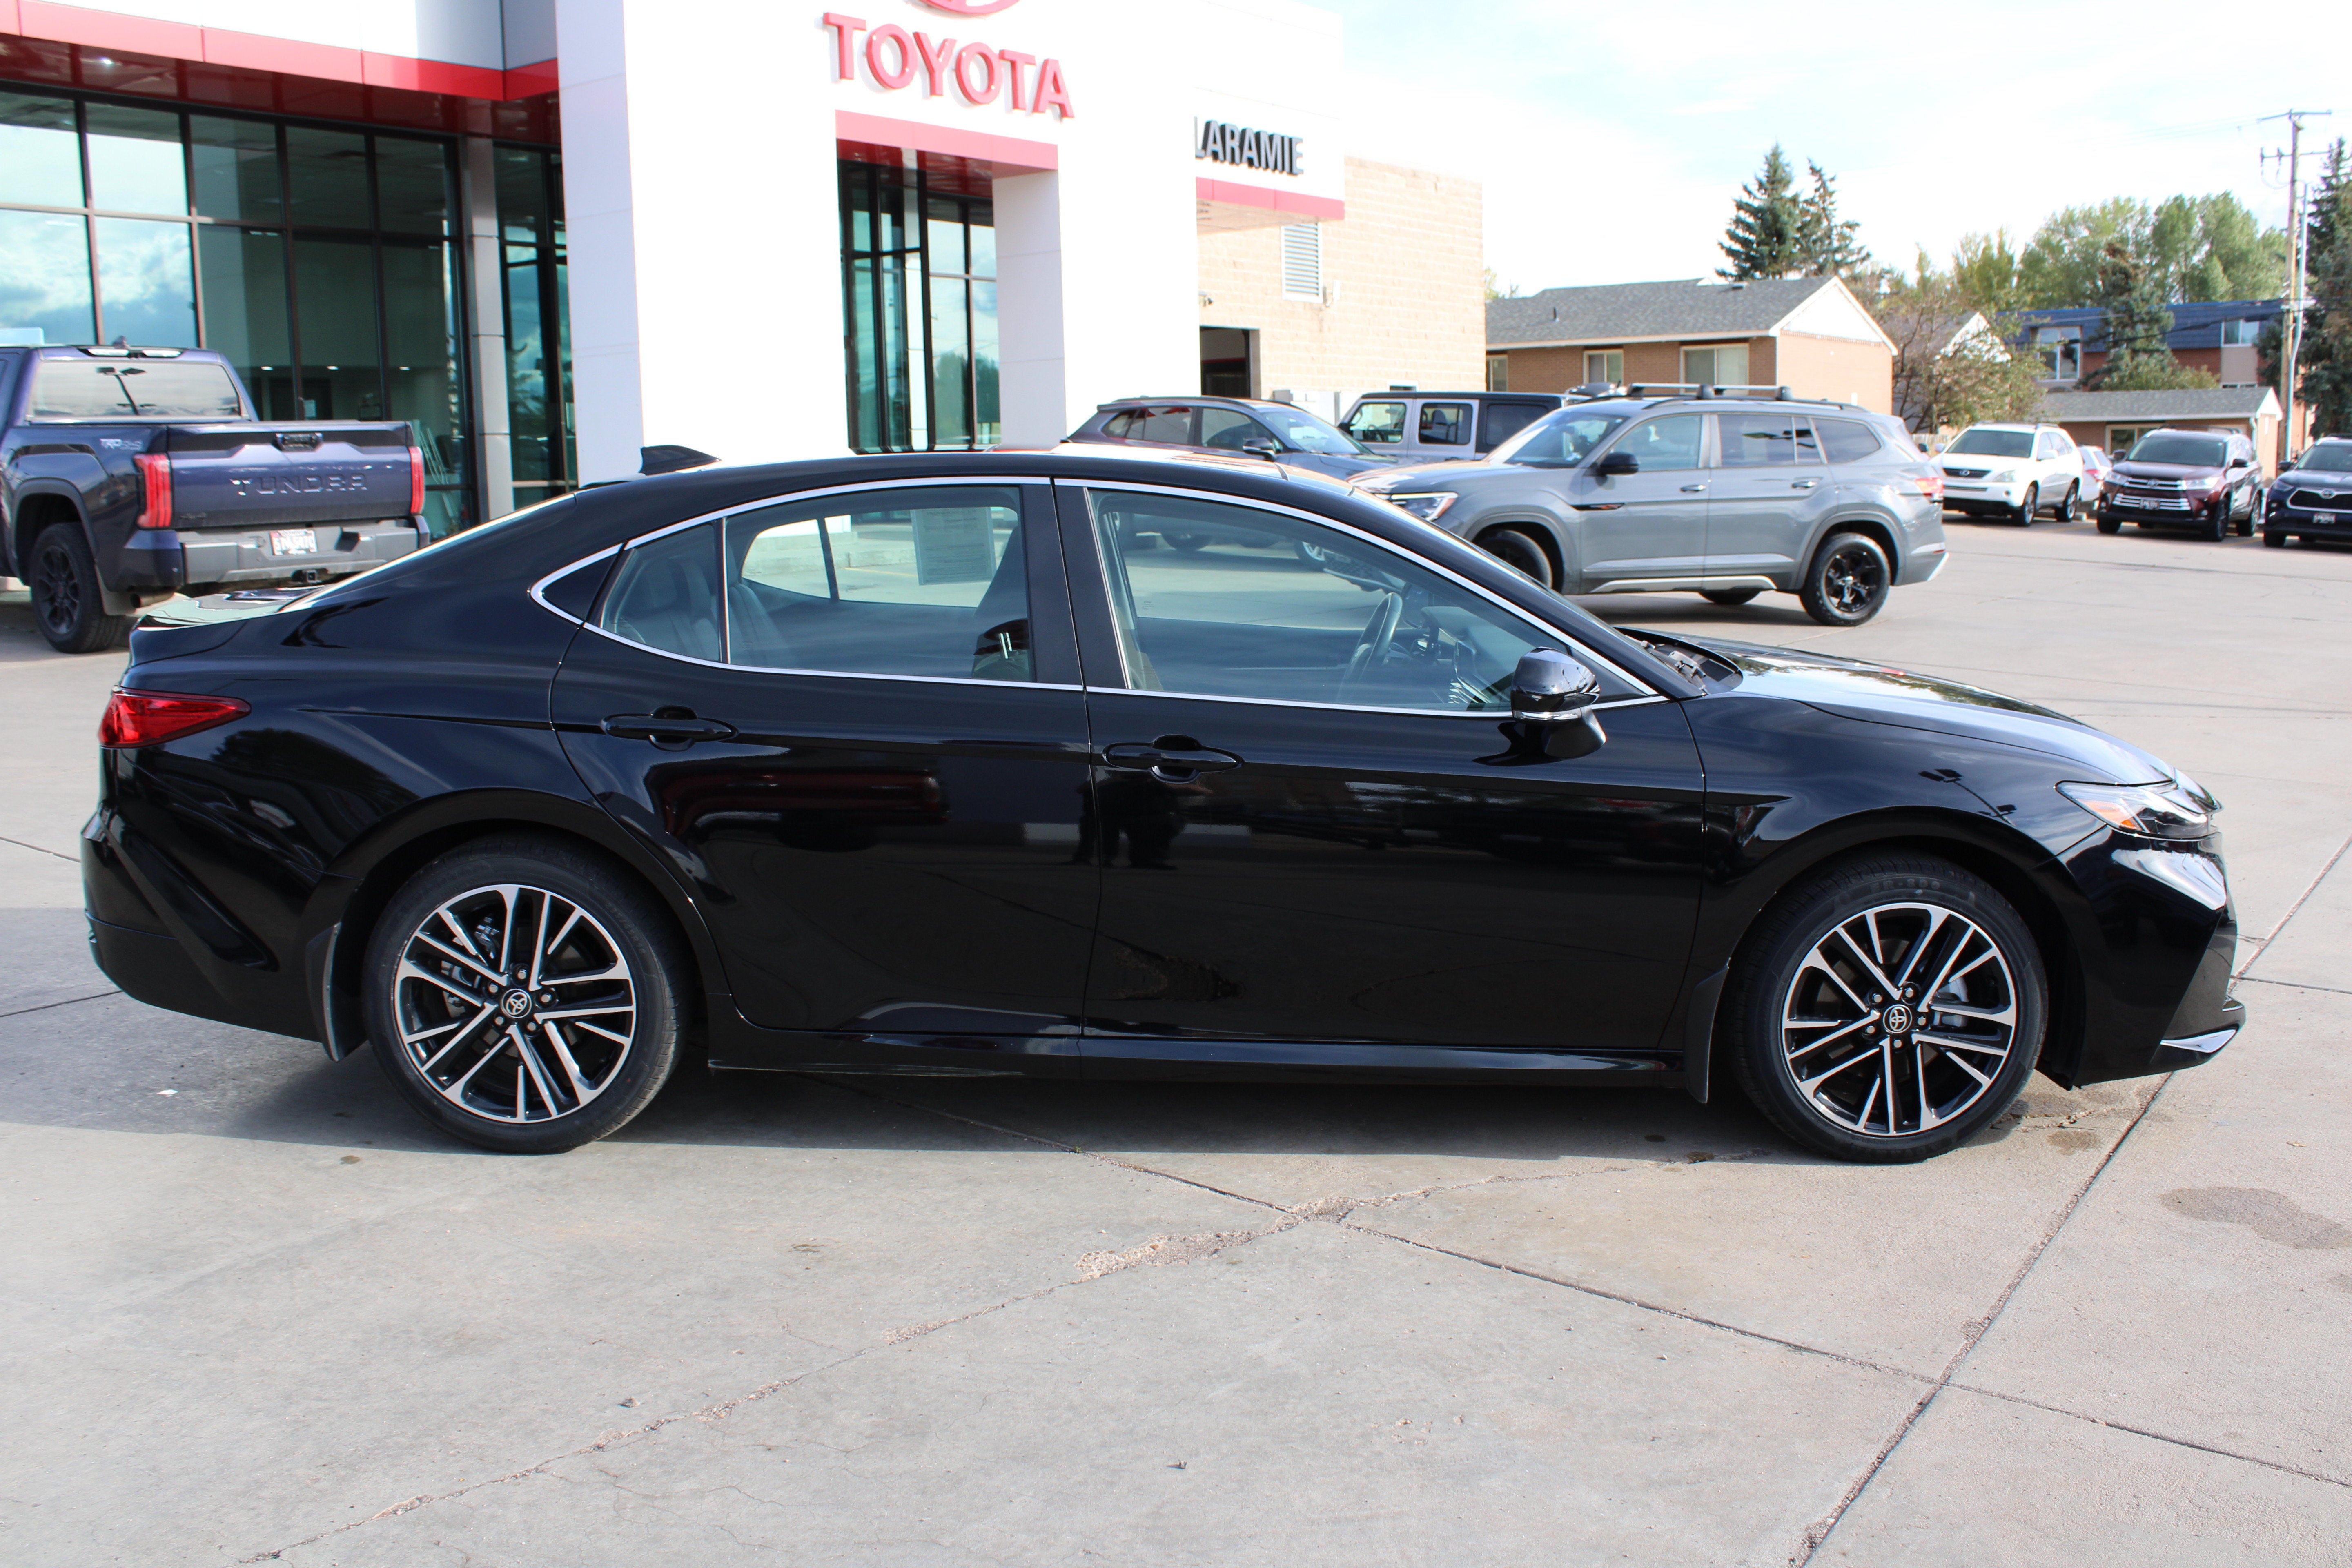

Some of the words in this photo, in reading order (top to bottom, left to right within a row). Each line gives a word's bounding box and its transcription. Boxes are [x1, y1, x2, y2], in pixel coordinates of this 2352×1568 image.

[822, 11, 1075, 119] TOYOTA
[1194, 116, 1304, 176] LARAMIE
[229, 472, 368, 497] TUNDRA
